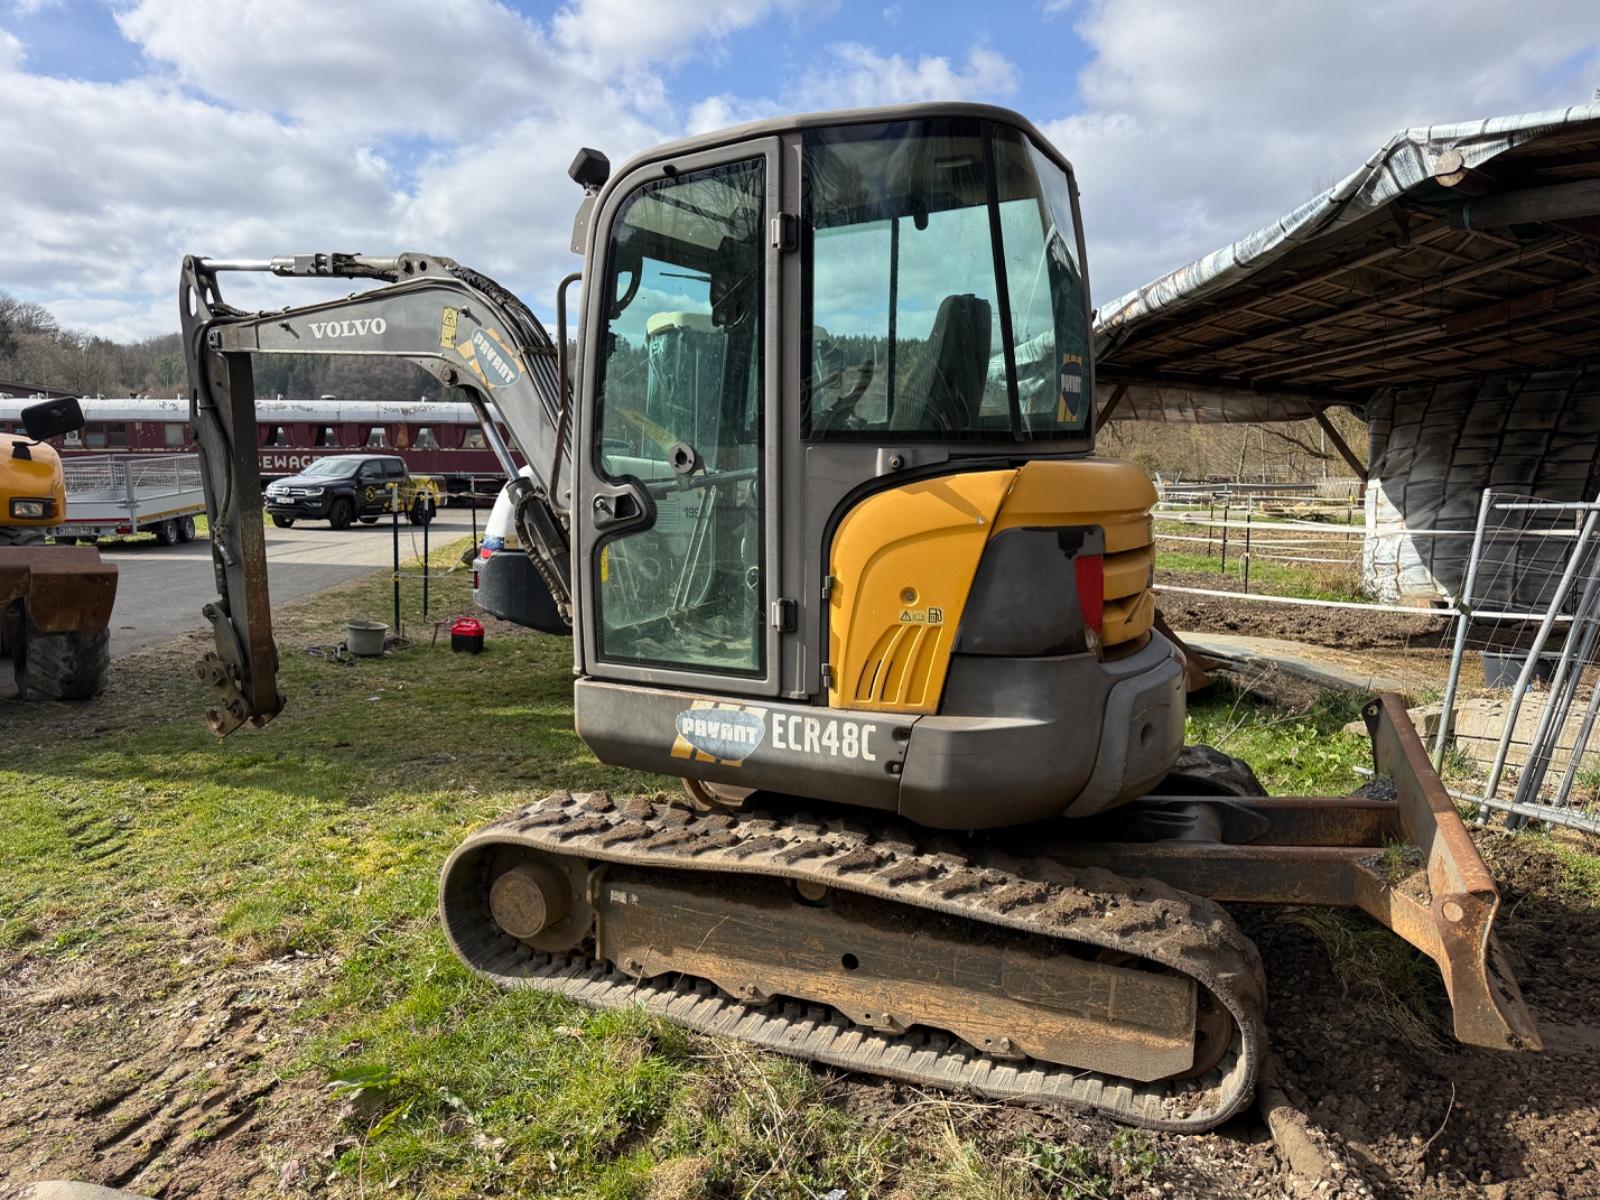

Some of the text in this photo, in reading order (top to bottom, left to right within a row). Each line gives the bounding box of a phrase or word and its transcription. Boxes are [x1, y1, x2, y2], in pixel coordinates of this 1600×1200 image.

[308, 317, 387, 339] VOLVO
[473, 331, 516, 383] PAYANT
[258, 455, 321, 469] EWAG
[682, 717, 758, 744] PAYANT
[772, 713, 877, 762] ECR48C
